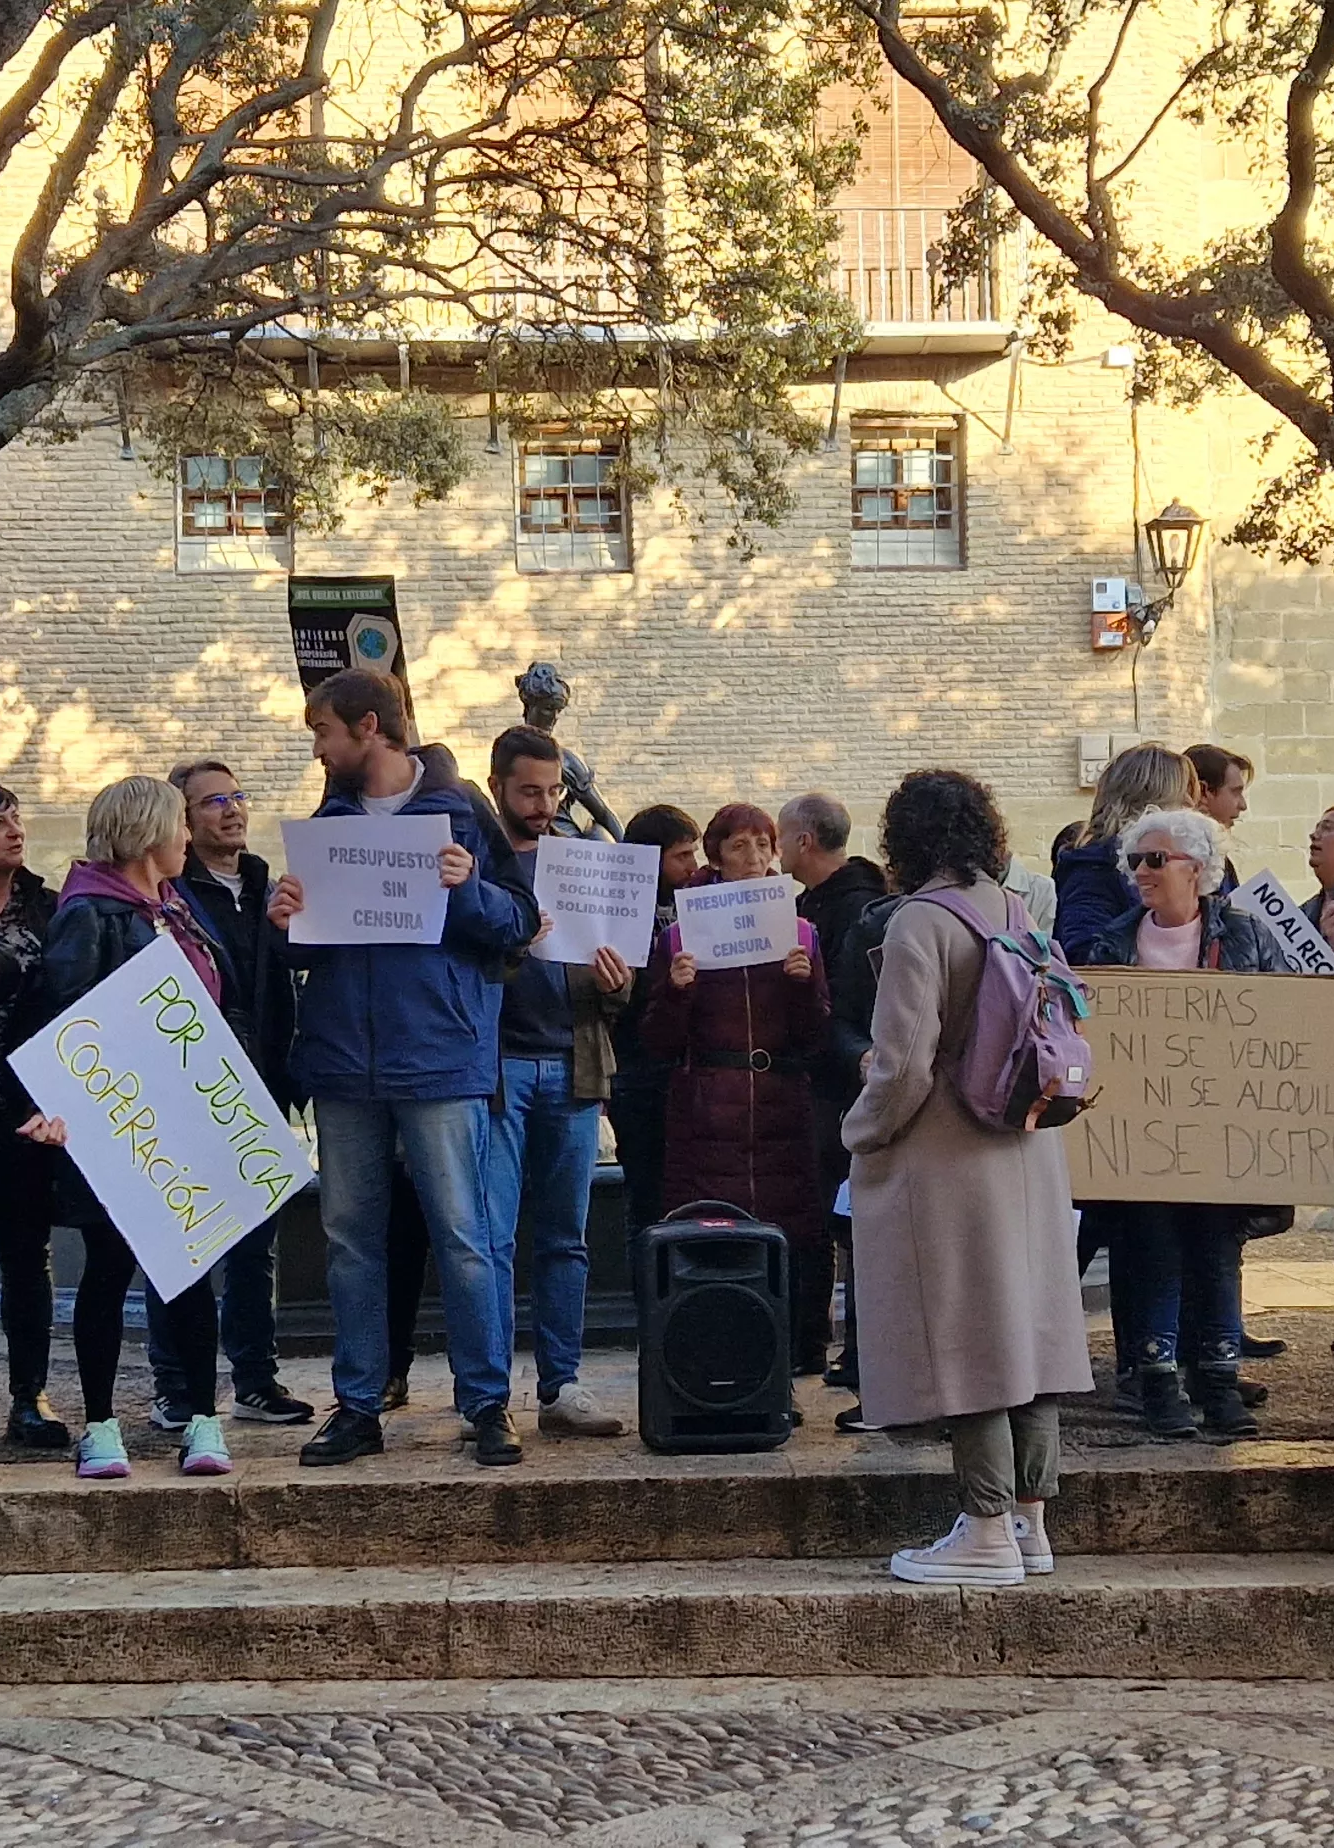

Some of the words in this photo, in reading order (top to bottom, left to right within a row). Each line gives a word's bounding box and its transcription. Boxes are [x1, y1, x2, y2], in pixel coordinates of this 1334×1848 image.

[565, 847, 595, 861] POR
[597, 849, 635, 866] UNOS
[546, 863, 655, 886] PRESUPUESTOS
[381, 880, 408, 899] SIN
[558, 882, 626, 900] SOCIALES
[630, 889, 641, 901] Y
[686, 885, 786, 912] PRESUPUESTOS
[353, 909, 424, 931] CENSURA
[555, 899, 639, 919] SOLIDARIOS
[1252, 882, 1285, 918] NO
[1276, 914, 1303, 944] AL
[733, 915, 756, 931] SIN
[712, 936, 773, 959] CENSURA
[1109, 1031, 1147, 1067] NI
[1164, 1032, 1206, 1068] SE
[1229, 1038, 1312, 1071] VENDE
[139, 975, 205, 1069] POR
[195, 1057, 294, 1211] JUSTICIA
[1143, 1075, 1172, 1108] NI
[1188, 1076, 1220, 1108] SE
[1083, 1115, 1130, 1179] NI
[1141, 1119, 1202, 1177] SE
